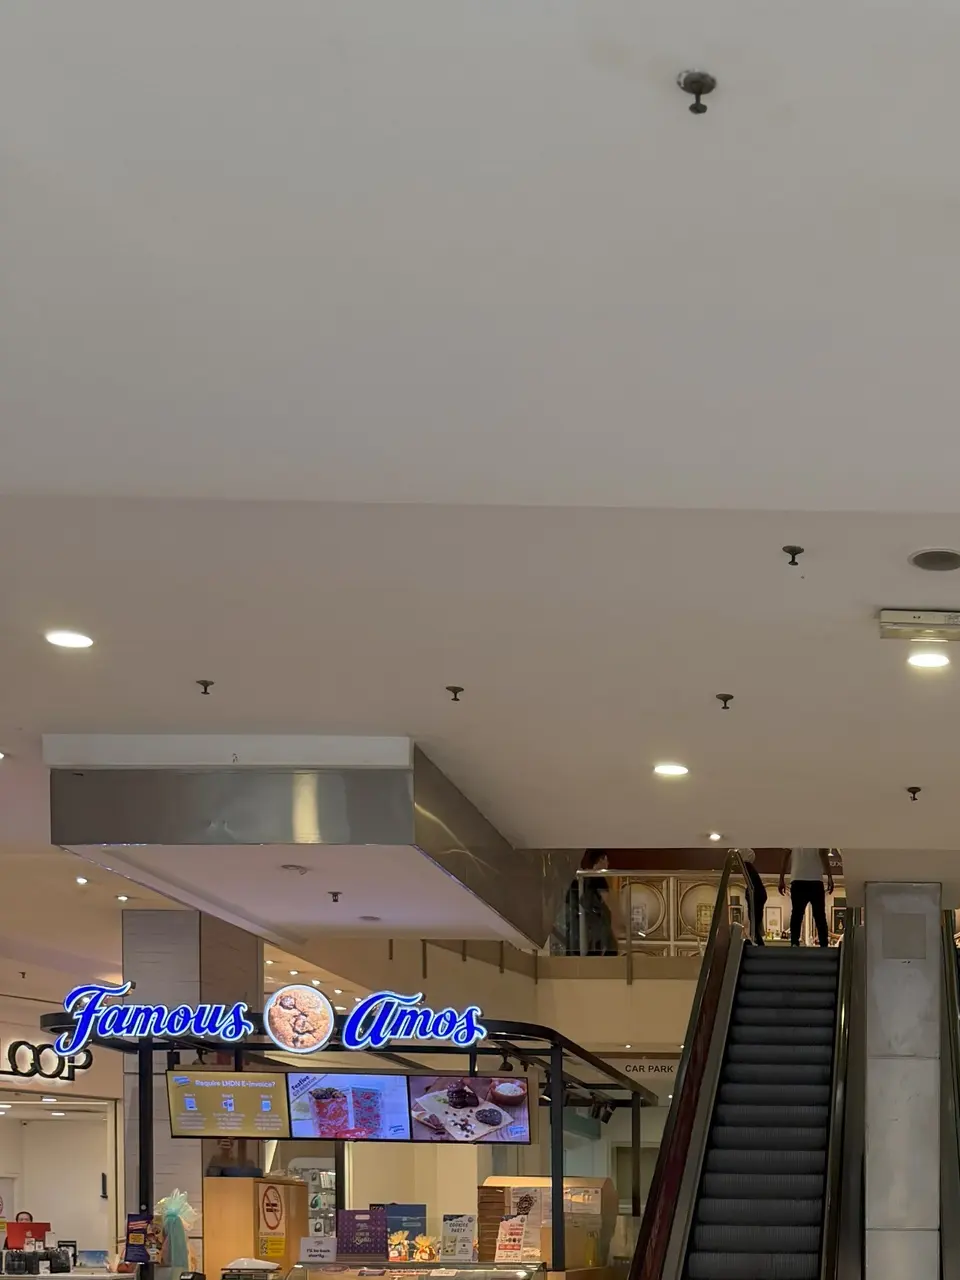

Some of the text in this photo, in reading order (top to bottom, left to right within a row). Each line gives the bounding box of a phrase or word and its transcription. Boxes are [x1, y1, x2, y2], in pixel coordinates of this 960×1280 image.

[55, 980, 488, 1056] Famous Amos
[625, 1064, 674, 1073] CAR PARK
